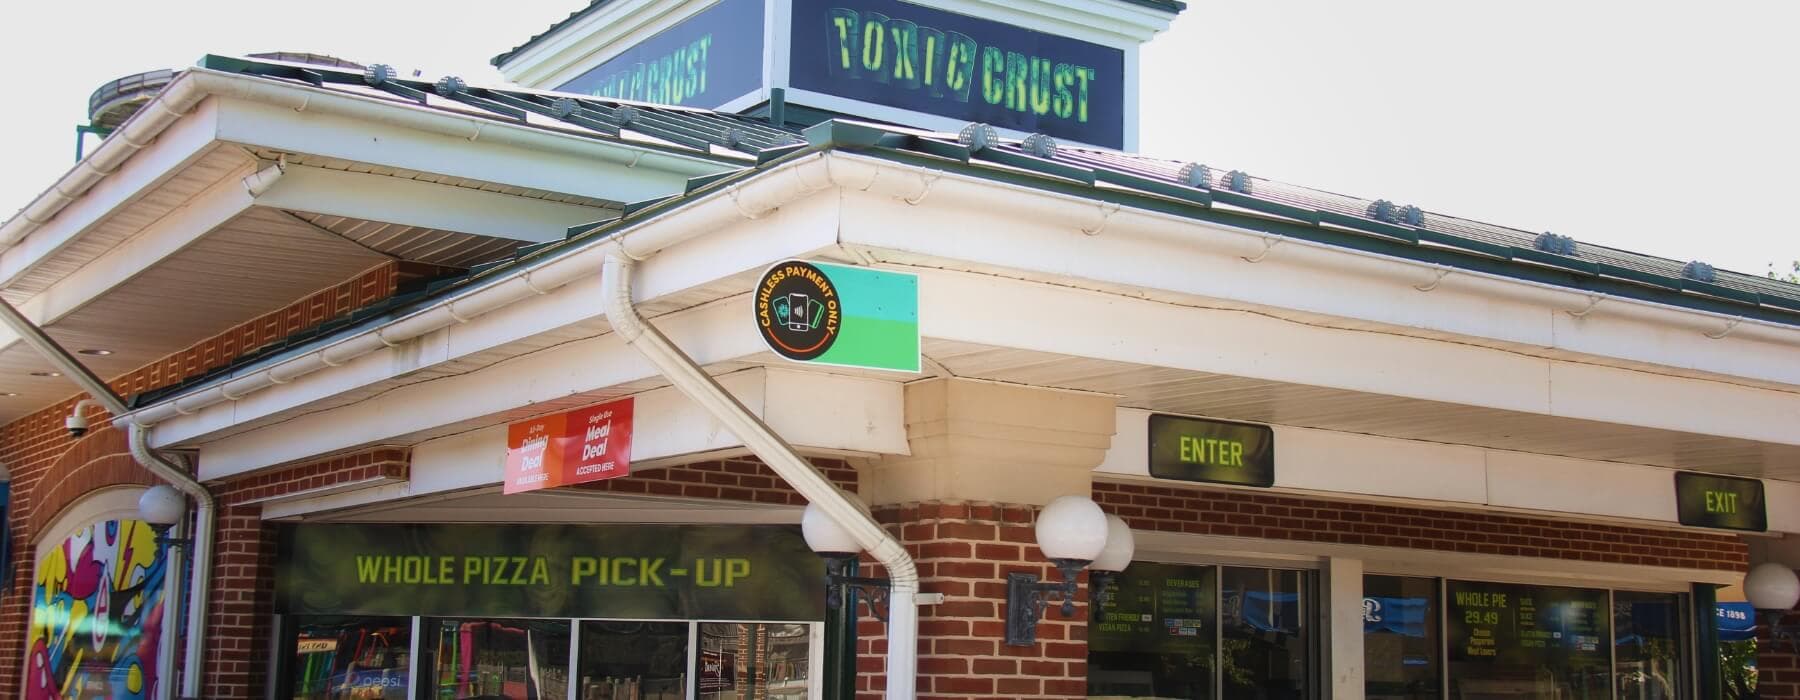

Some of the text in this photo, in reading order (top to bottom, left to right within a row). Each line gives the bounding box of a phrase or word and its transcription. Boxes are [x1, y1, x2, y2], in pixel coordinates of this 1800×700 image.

[647, 34, 712, 104] CRUST
[833, 16, 1095, 123] TOXIC CRUST
[759, 266, 838, 334] CASHLESS PAYMENT ONLY
[585, 419, 611, 443] Meal
[521, 433, 549, 454] Dining
[582, 437, 608, 461] Deal
[1180, 436, 1243, 467] ENTER
[521, 449, 545, 472] Deal
[576, 461, 615, 475] ACCEPTED HERE
[1705, 491, 1737, 514] EXIT
[356, 555, 454, 584] WHOLE
[463, 555, 550, 585] PIZZA
[1456, 591, 1489, 607] WHOLE
[1492, 593, 1507, 608] PIE
[1465, 610, 1499, 624] 29.49
